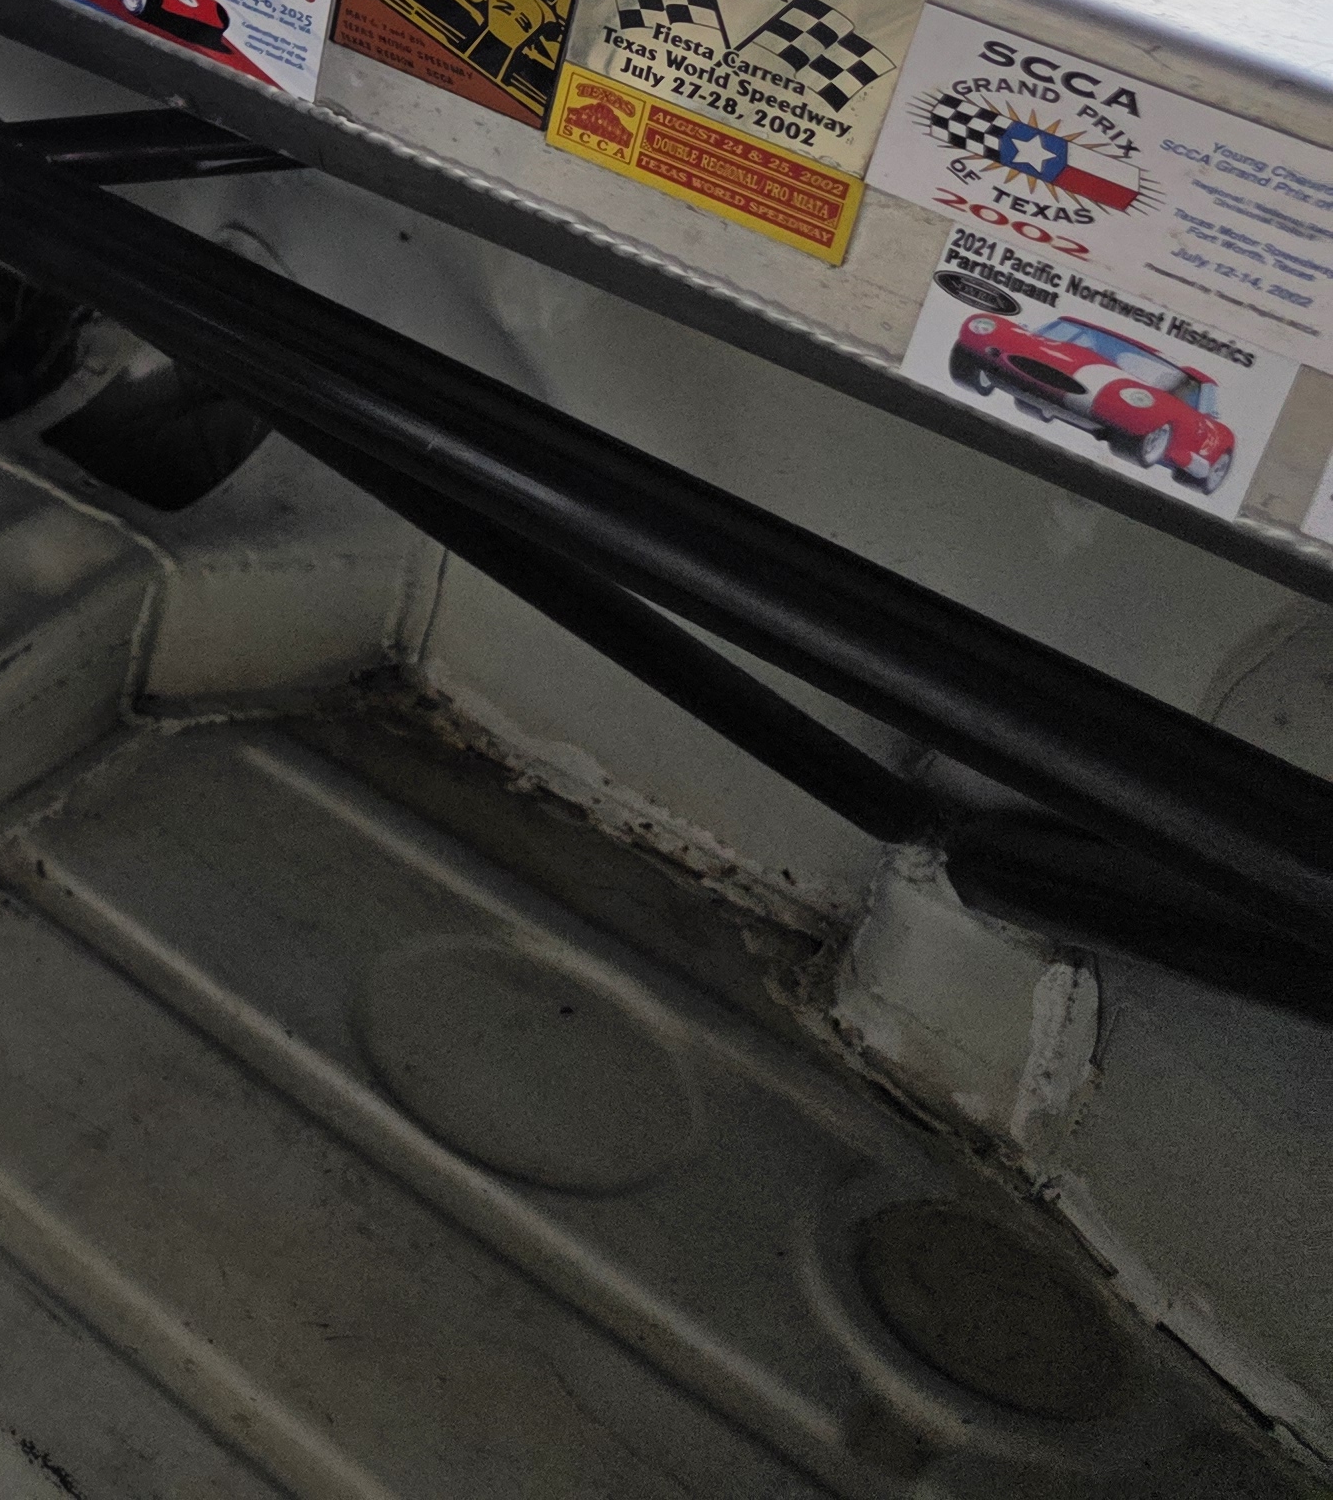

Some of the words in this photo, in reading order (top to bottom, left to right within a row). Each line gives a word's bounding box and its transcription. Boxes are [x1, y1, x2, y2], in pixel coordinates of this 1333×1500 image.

[280, 4, 313, 27] 2025
[603, 26, 659, 62] Texas
[666, 50, 731, 90] World
[736, 78, 852, 138] Speedway
[652, 23, 714, 61] Fiesta
[721, 48, 806, 96] Carrera
[978, 40, 1141, 118] SCCA
[620, 57, 665, 89] July
[671, 77, 746, 120] 27-28,
[753, 110, 818, 148] 2002
[951, 77, 1061, 104] GRAND
[1076, 103, 1141, 159] PRIX
[653, 111, 721, 145] AUGUST
[722, 138, 744, 155] 24
[748, 148, 764, 163] &
[799, 169, 844, 196] 2002
[653, 134, 699, 165] DOUBLE
[792, 191, 830, 219] MIATA
[949, 158, 982, 183] OF
[991, 186, 1095, 225] TEXAS
[1160, 139, 1210, 166] SCCA
[1216, 160, 1271, 187] Grand
[1213, 142, 1269, 172] Young
[640, 156, 687, 182] TEXAS
[692, 178, 745, 207] WORLD
[748, 201, 832, 243] SPEEDWAY
[932, 187, 1090, 262] 2002
[944, 248, 1061, 309] Participant
[1170, 248, 1210, 269] July
[950, 227, 998, 257] 2021
[999, 247, 1062, 289] Pacific
[1065, 273, 1165, 332] Northwest
[1166, 316, 1257, 368] Historics
